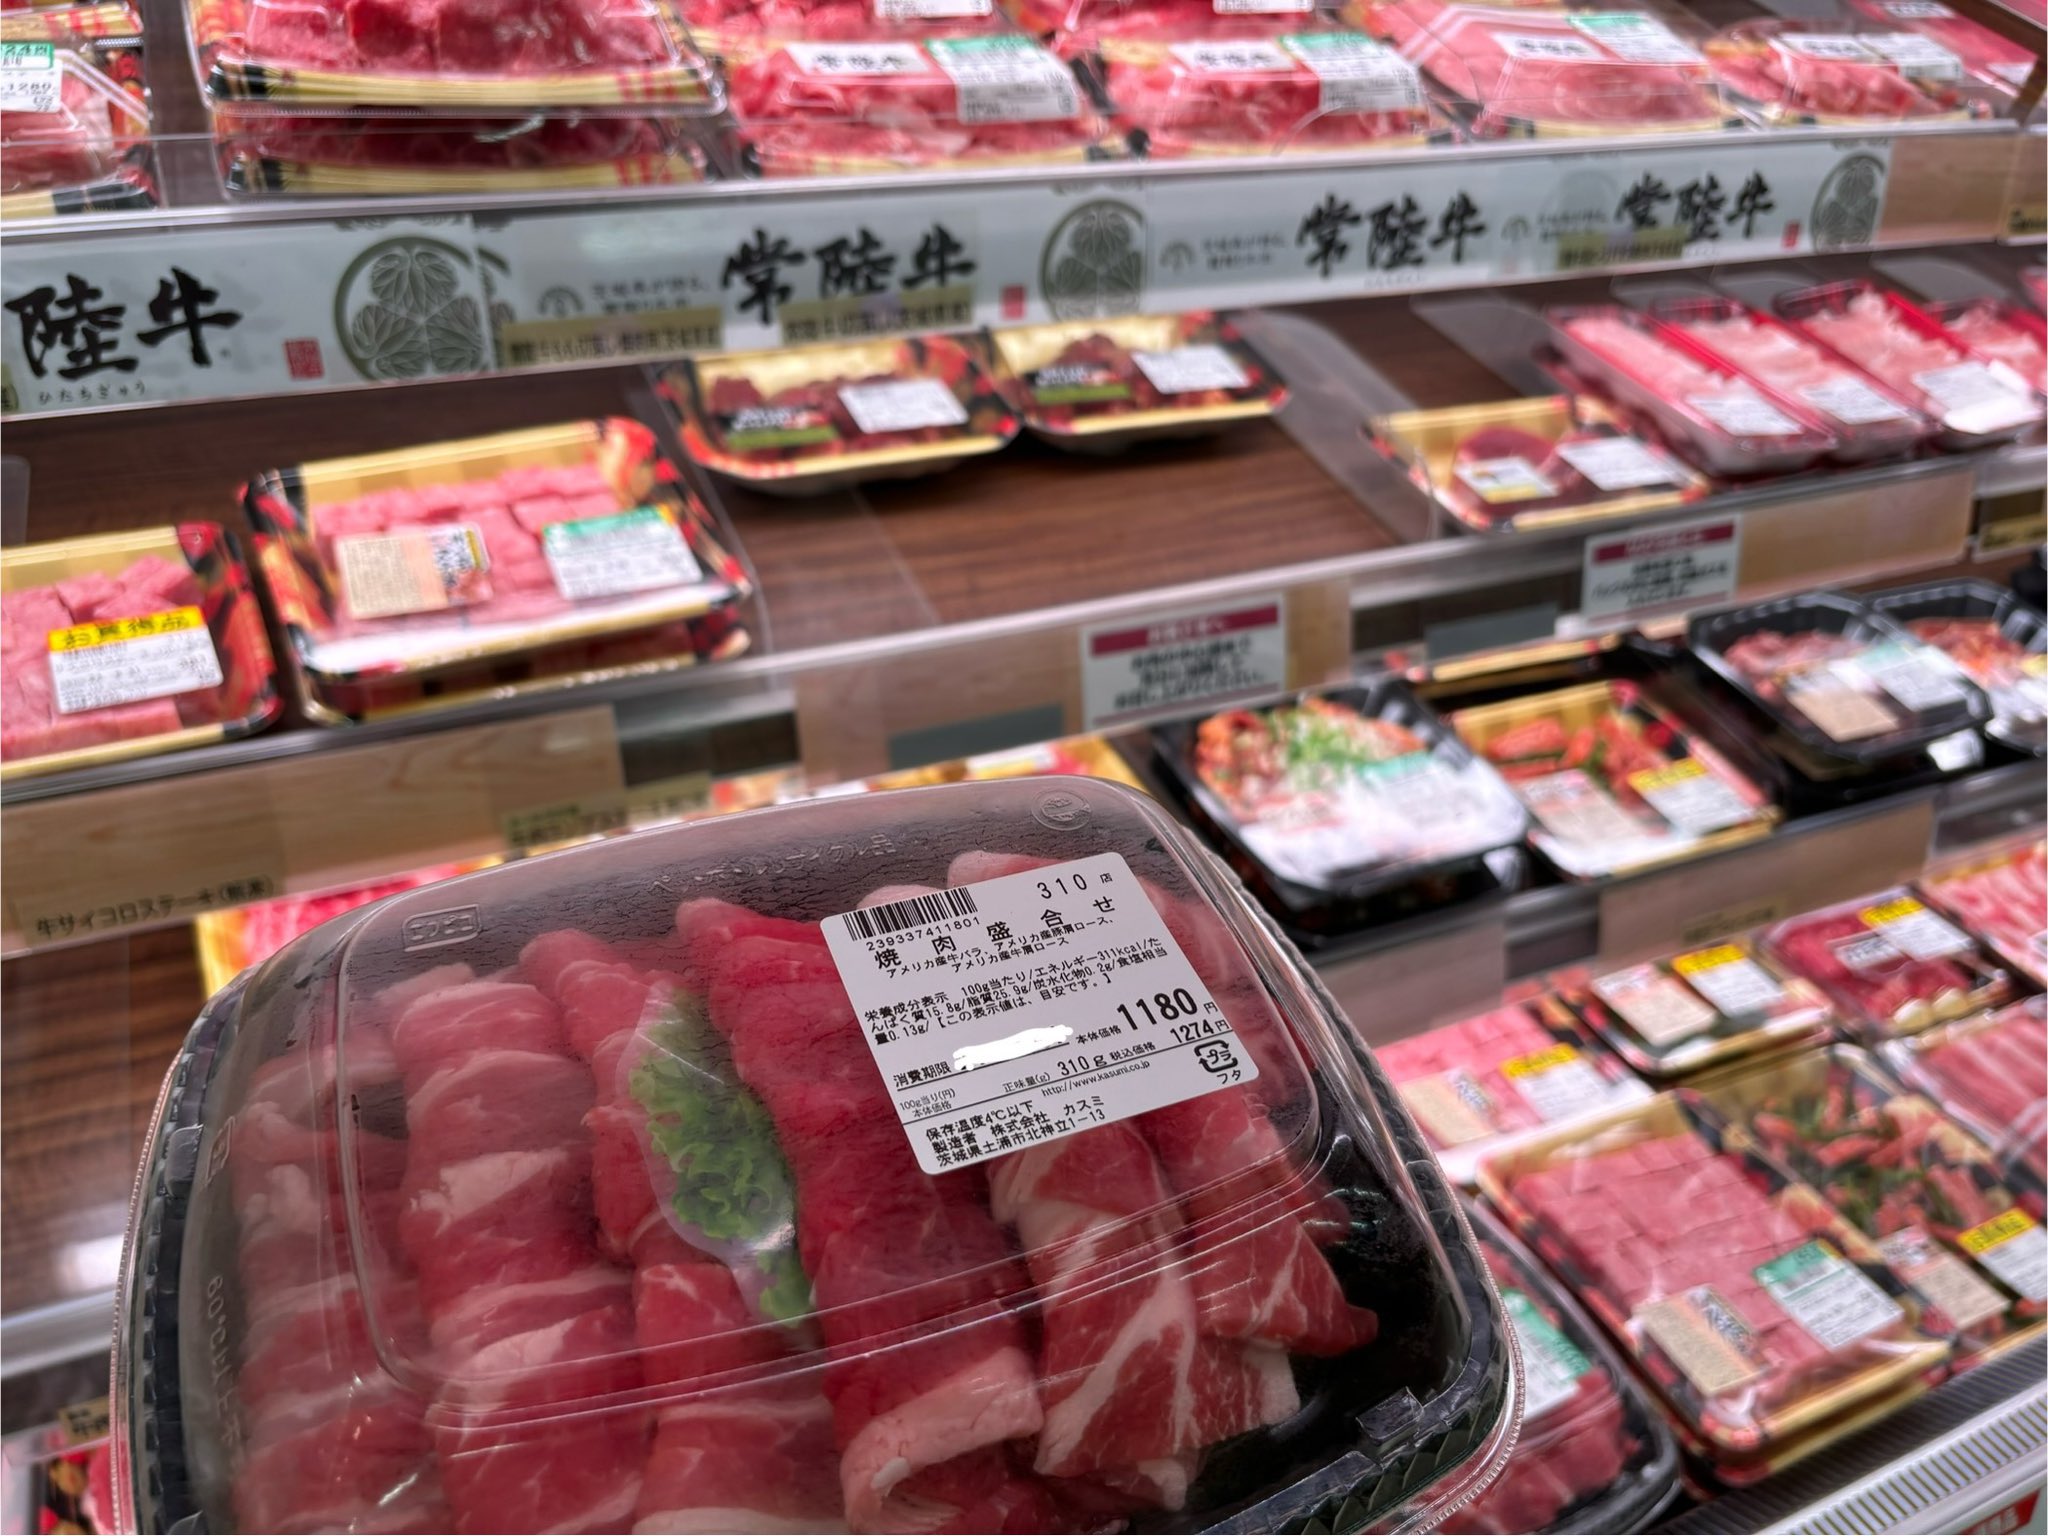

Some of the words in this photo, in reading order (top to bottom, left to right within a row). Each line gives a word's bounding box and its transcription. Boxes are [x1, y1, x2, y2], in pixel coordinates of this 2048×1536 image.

[1613, 169, 1777, 242] 常陸牛
[1294, 191, 1487, 279] 常陸牛
[720, 225, 978, 327] 常陸牛
[37, 380, 147, 405] ひたちぎゅう
[1036, 873, 1088, 900] 310
[1099, 872, 1114, 884] 店
[865, 916, 981, 952] 239337411801
[951, 936, 1070, 974] アメリカ産牛肩ロース
[865, 991, 950, 1023] 栄養成分表示
[1075, 1024, 1123, 1046] 本体価格
[1116, 987, 1199, 1031] 1180
[1203, 1001, 1219, 1015] 円
[1109, 1041, 1157, 1062] 税込価格
[1169, 1018, 1215, 1044] 1274
[1214, 1018, 1231, 1033] 円
[893, 1060, 952, 1088] 消費期限
[1002, 1071, 1051, 1093] 正味量(g)
[1056, 1055, 1090, 1077] 310
[1040, 1060, 1151, 1098] http://www.kasumi.co.jp
[1216, 1068, 1242, 1086] フタ
[899, 1087, 957, 1112] 100g当り(円)
[913, 1101, 953, 1119] 本体価格
[925, 1099, 1034, 1142] 保存温度4℃以下
[932, 1131, 977, 1155] 製造者
[989, 1110, 1050, 1139] 株式会社
[1062, 1094, 1106, 1116] カスミ
